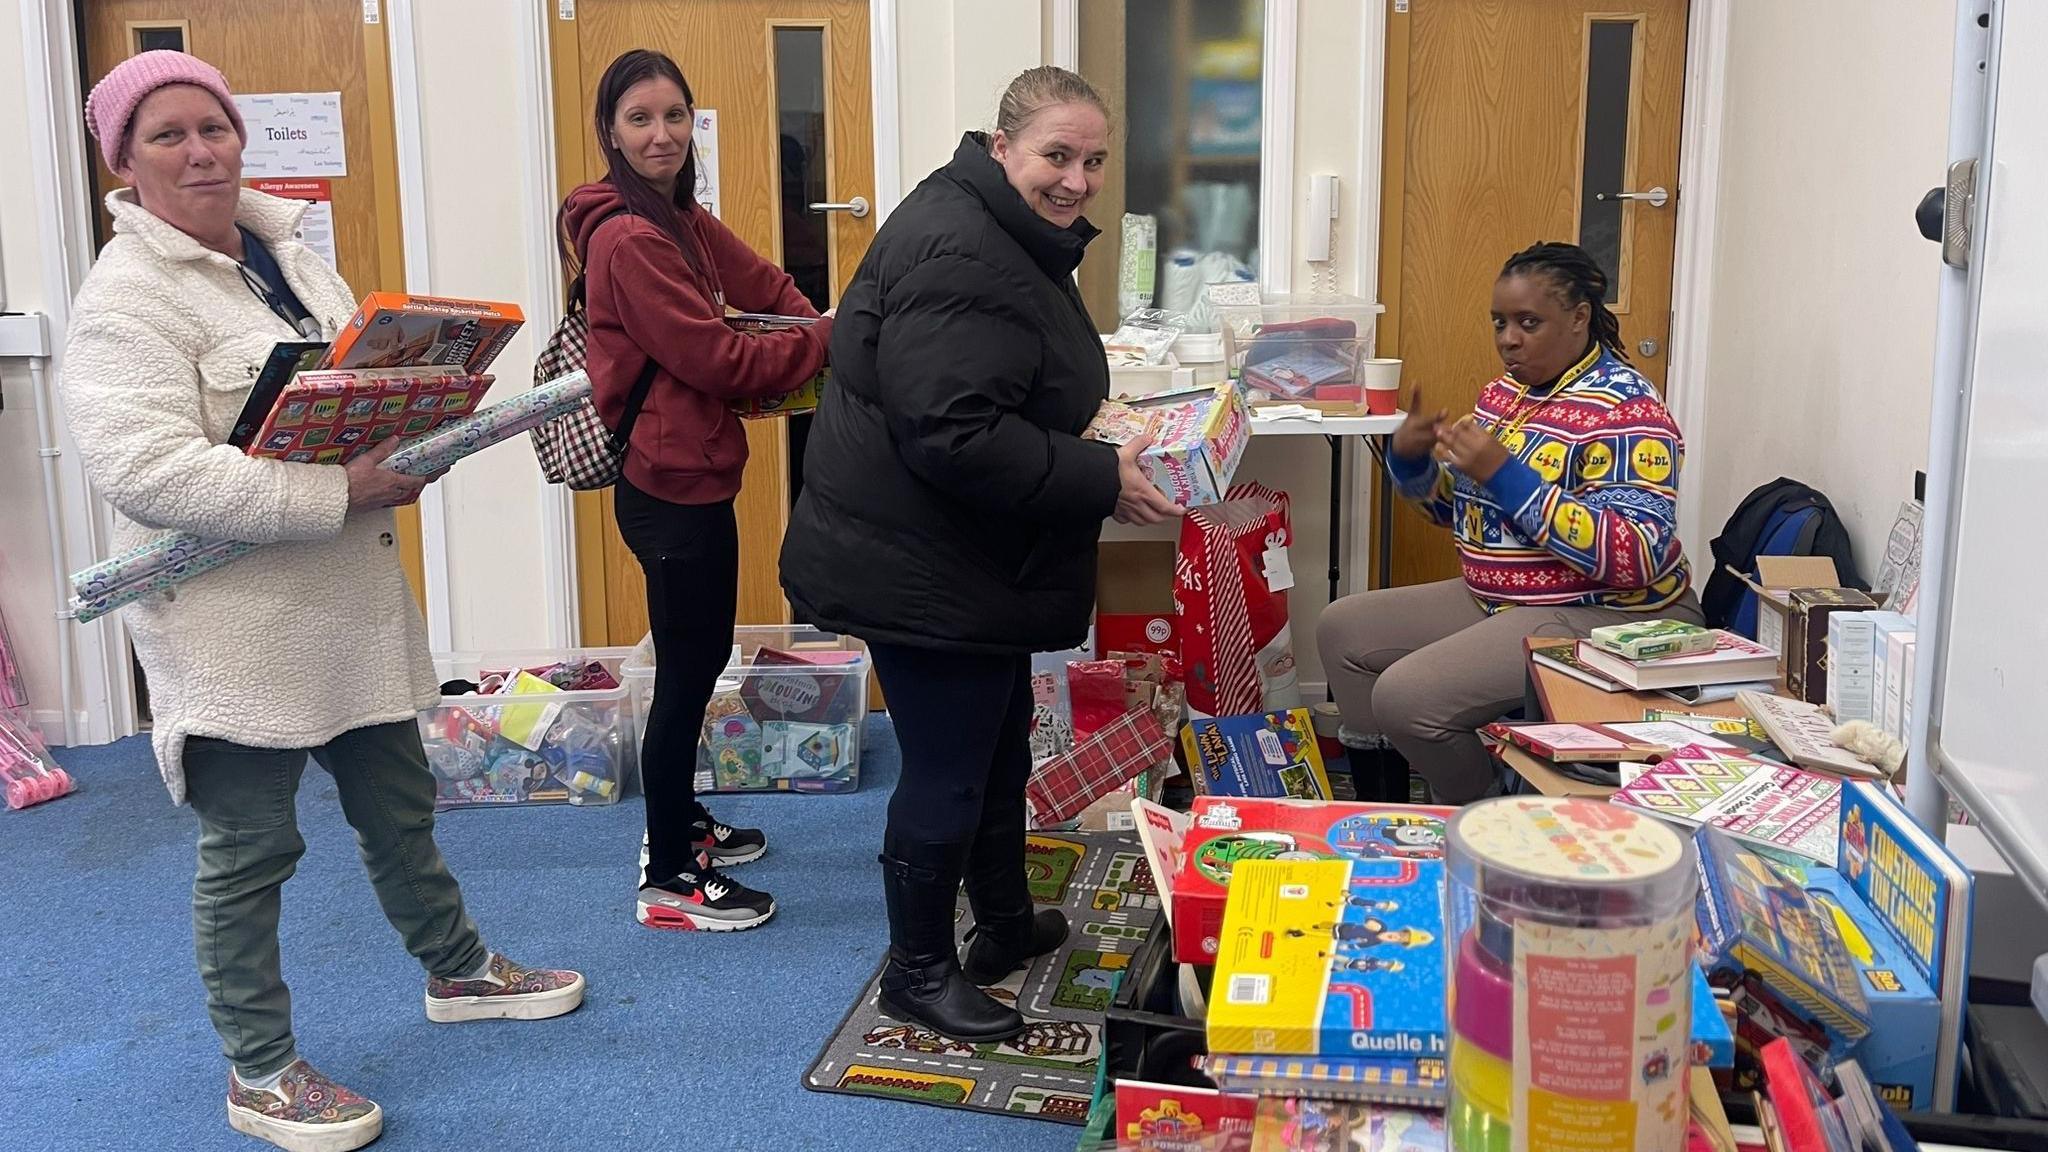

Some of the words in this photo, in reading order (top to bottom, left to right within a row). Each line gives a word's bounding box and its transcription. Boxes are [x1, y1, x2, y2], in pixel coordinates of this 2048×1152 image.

[265, 127, 307, 140] Toilets
[260, 183, 283, 191] Allergy
[1638, 453, 1669, 467] LIDL
[1164, 462, 1184, 498] GARDEN
[1175, 464, 1191, 493] FAIRY
[1567, 509, 1582, 542] LIDL
[1150, 626, 1167, 636] 99p
[1199, 734, 1219, 766] LAWN
[1206, 722, 1229, 760] LAVA!
[1752, 782, 1776, 797] Colour
[1871, 822, 1936, 926] CONSTRUIS
[1869, 861, 1890, 916] TON
[1890, 884, 1934, 966] CAMION
[1352, 1031, 1422, 1051] Quelle
